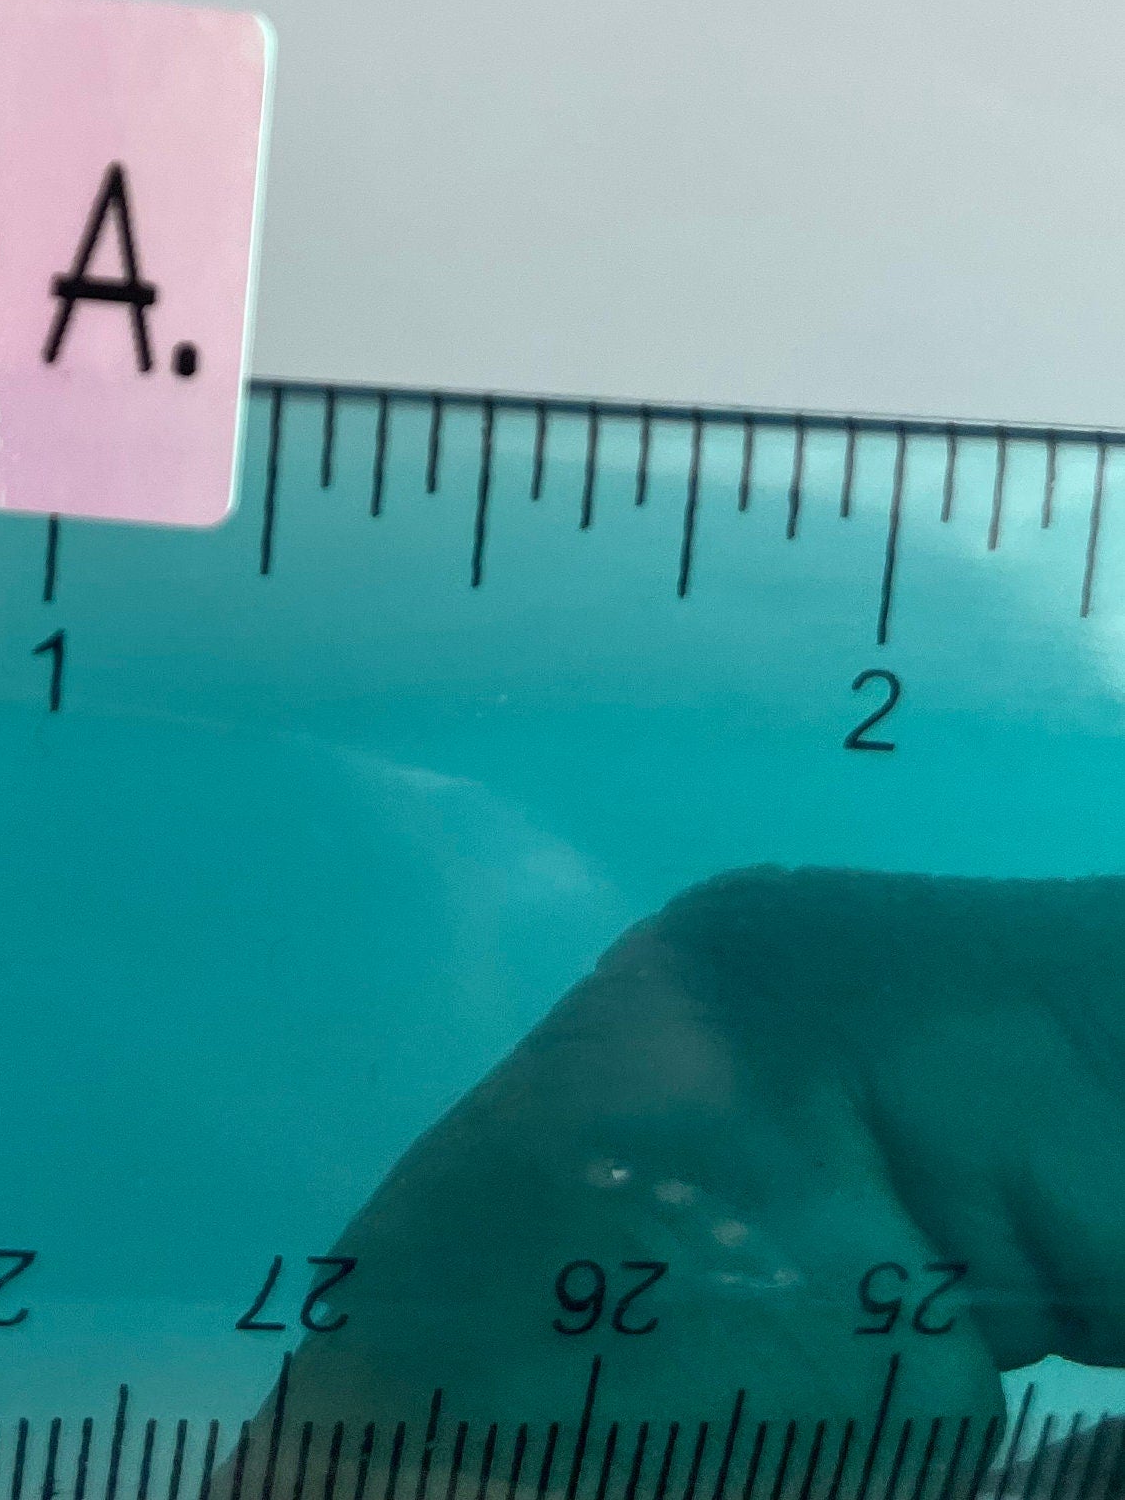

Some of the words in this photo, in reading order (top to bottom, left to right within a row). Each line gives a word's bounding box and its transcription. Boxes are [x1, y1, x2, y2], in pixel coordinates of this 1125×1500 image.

[46, 163, 201, 378] A.
[29, 629, 68, 714] 1
[842, 668, 903, 752] 2
[234, 1254, 358, 1333] 27
[552, 1258, 669, 1336] 26
[852, 1259, 968, 1337] 25
